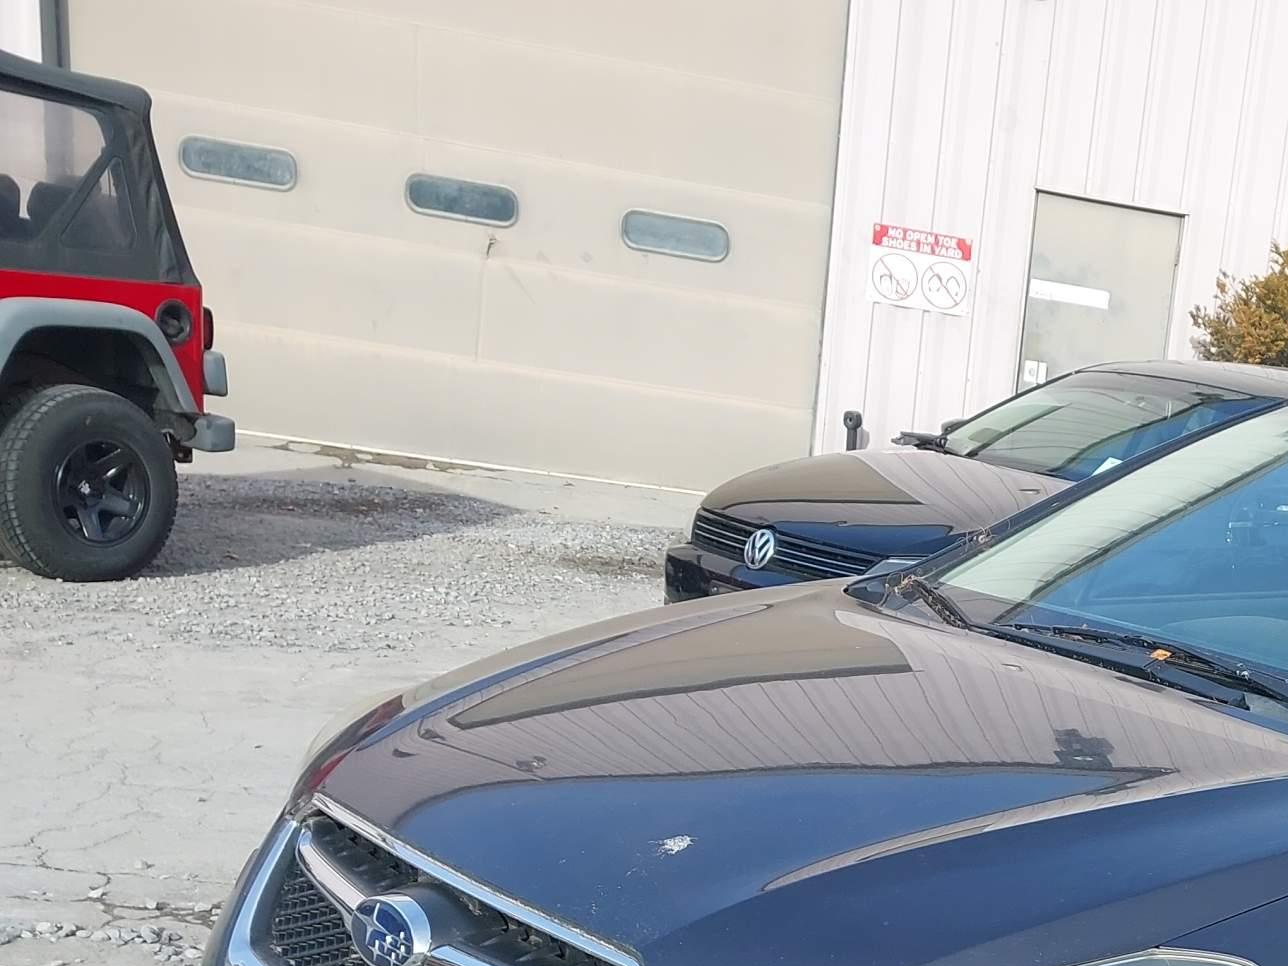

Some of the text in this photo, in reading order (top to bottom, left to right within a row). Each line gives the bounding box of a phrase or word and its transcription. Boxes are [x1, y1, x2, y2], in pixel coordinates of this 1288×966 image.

[882, 236, 963, 258] SHOES IN YARD
[887, 227, 958, 248] NO OPEN TOE
